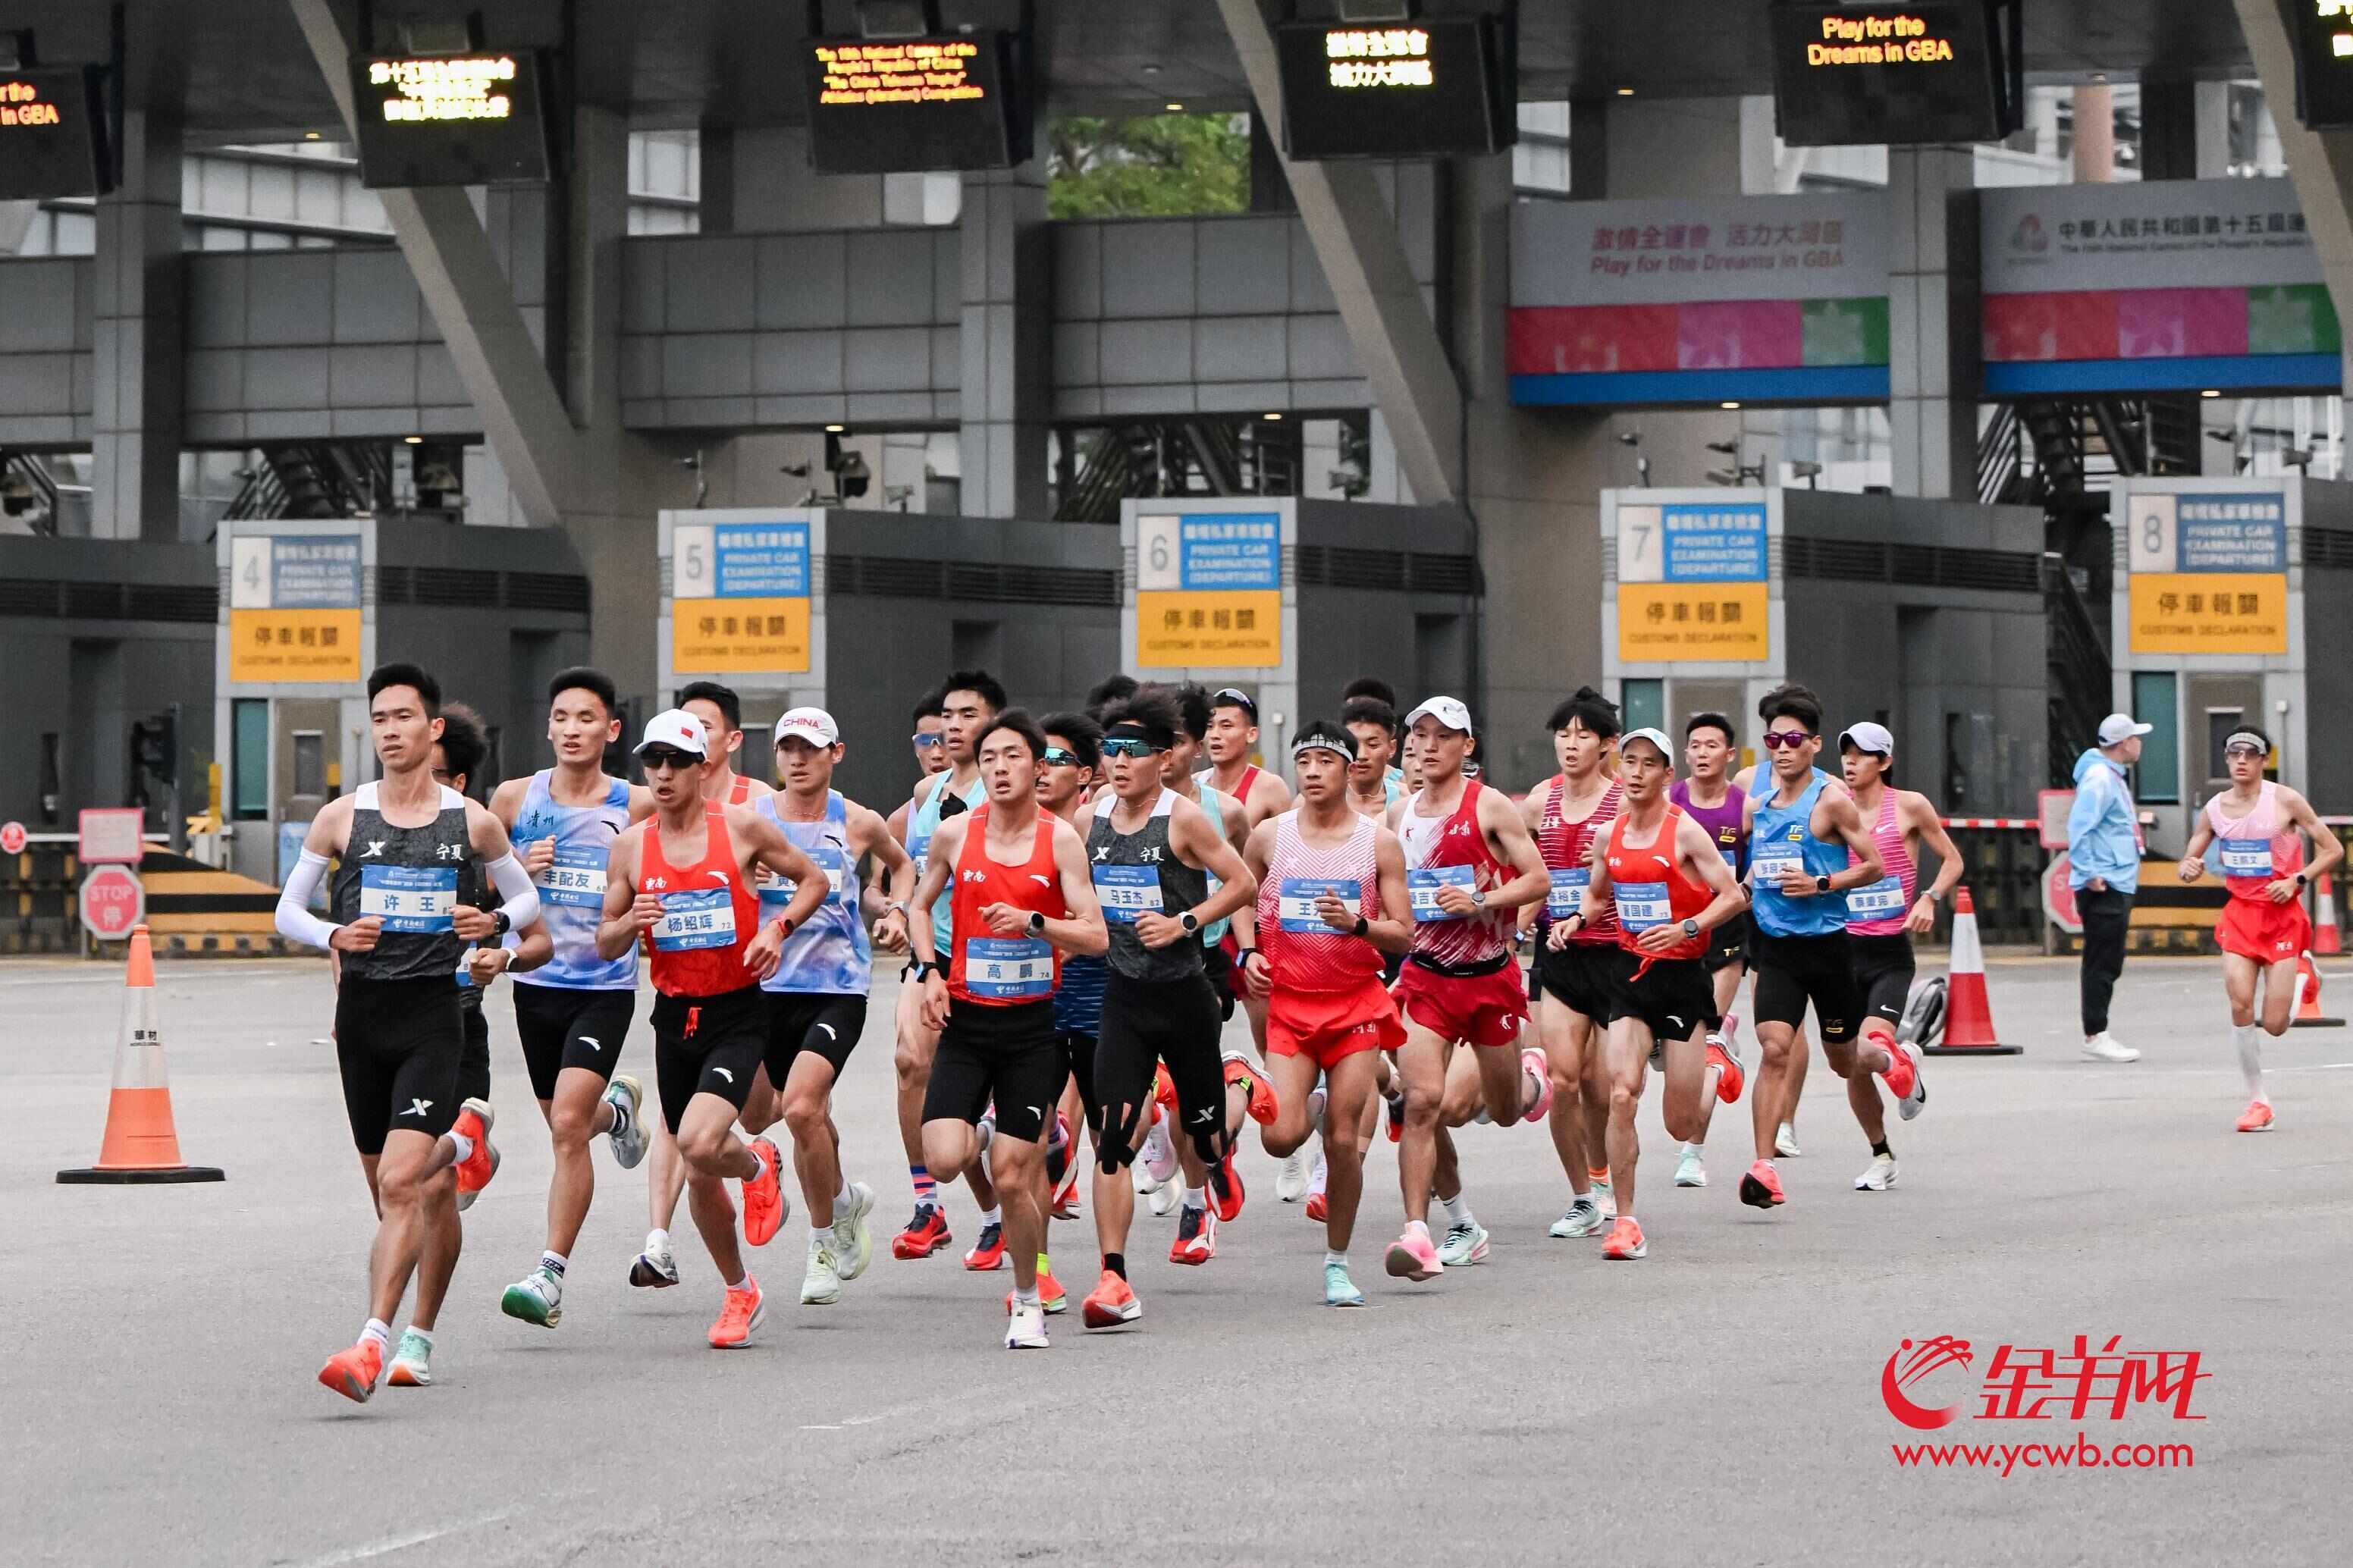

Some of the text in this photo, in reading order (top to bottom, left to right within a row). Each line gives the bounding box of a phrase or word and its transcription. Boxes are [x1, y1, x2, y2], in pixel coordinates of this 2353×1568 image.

[1822, 15, 1925, 42] Play for the
[1808, 39, 1953, 65] Dreams in GBA
[1, 104, 60, 125] in GBA
[1592, 249, 1844, 278] Play for the Dreams in GBA
[1630, 525, 1652, 562] 7
[2143, 514, 2162, 554] 8
[686, 544, 703, 581] 5
[1150, 533, 1169, 571] 6
[243, 555, 262, 590] 4
[783, 718, 819, 729] CHINA
[436, 842, 466, 861] 宁夏
[1140, 846, 1166, 862] 宁夏
[544, 870, 591, 889] 丰配友
[88, 886, 134, 902] STOP
